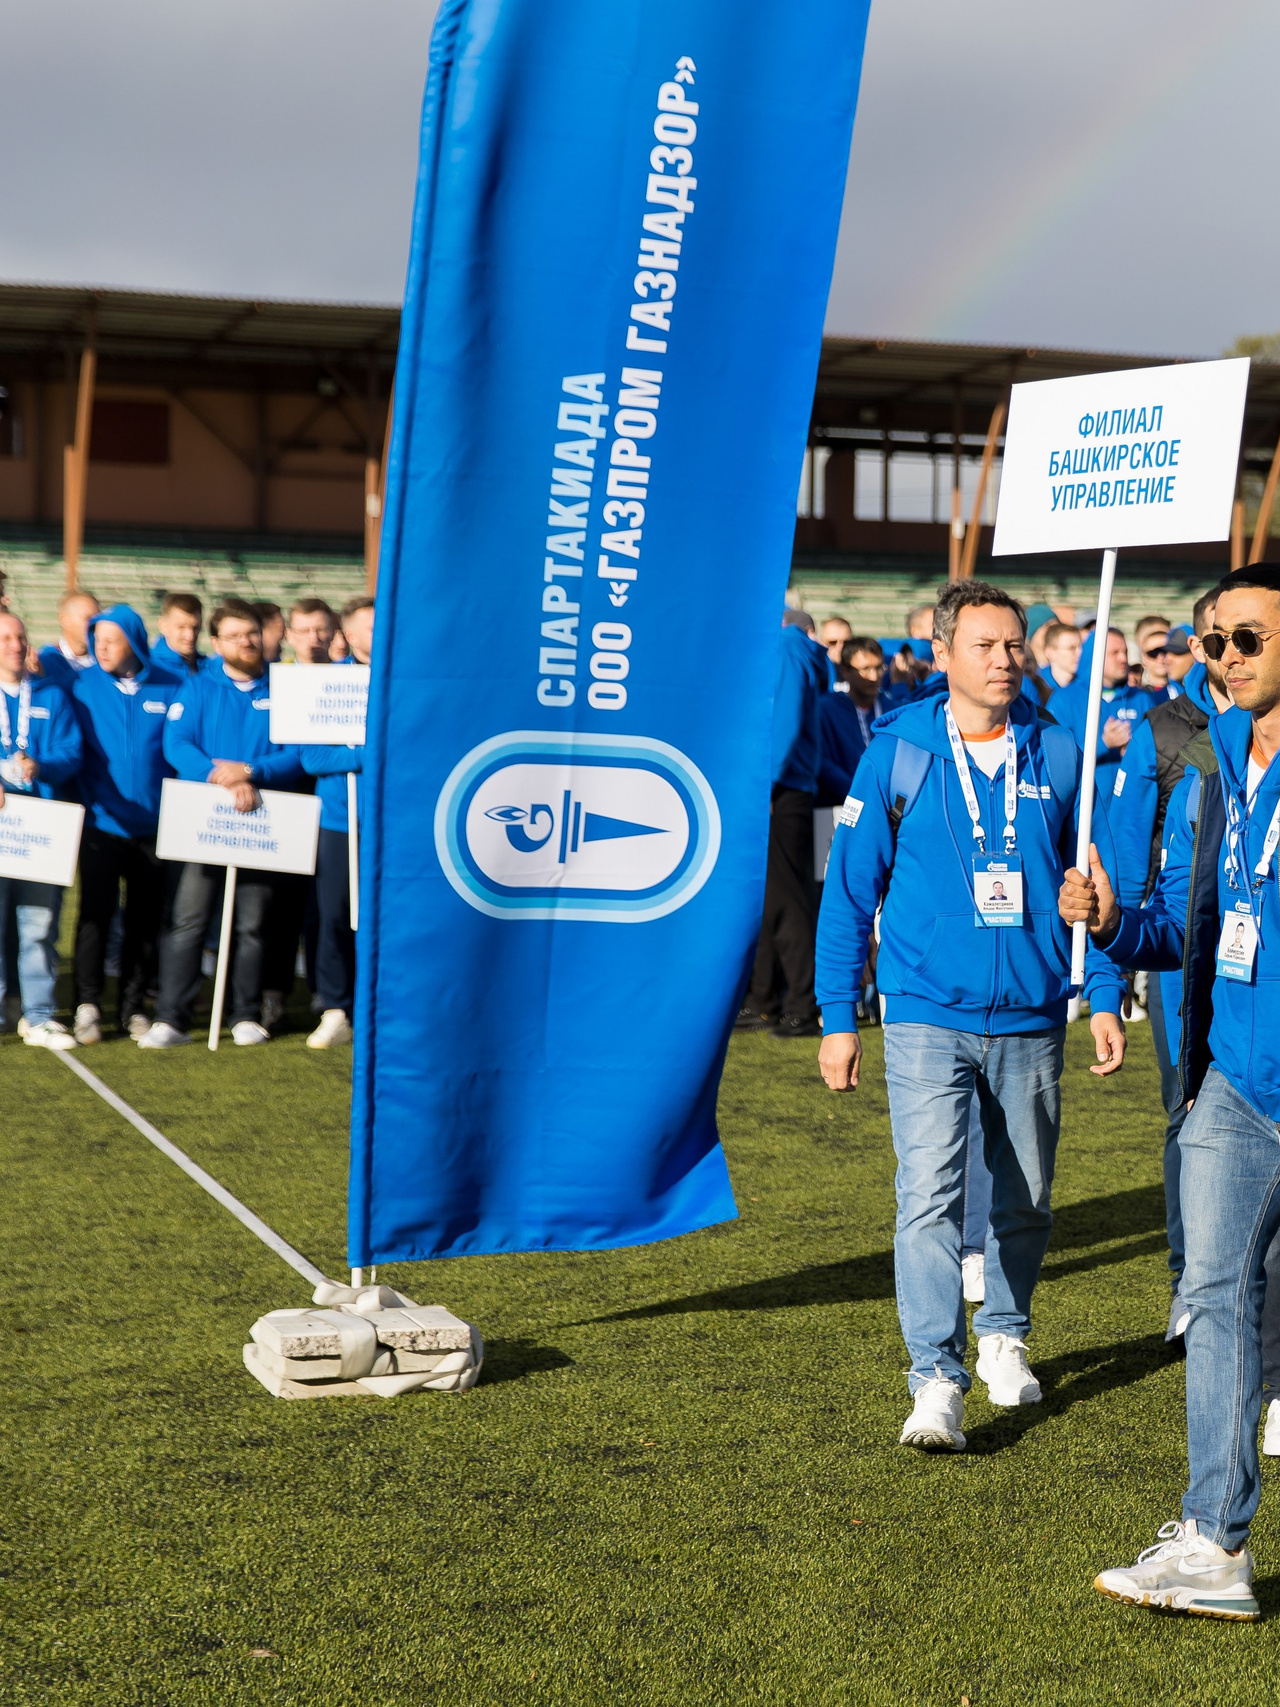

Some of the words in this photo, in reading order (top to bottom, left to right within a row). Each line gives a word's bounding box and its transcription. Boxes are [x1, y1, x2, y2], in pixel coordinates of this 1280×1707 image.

[625, 56, 699, 354] ГАЗНАДЗОР»
[1078, 405, 1163, 438] ФИЛИАЛ
[597, 366, 663, 607] «ГАЗПРОМ
[1048, 439, 1181, 477] БАШКИРСКОЕ
[1051, 475, 1176, 512] УПРАВЛЕНИЕ
[536, 372, 610, 708] СПАРТАКИАДА
[323, 683, 369, 695] ФИЛИА
[587, 621, 632, 711] ООО
